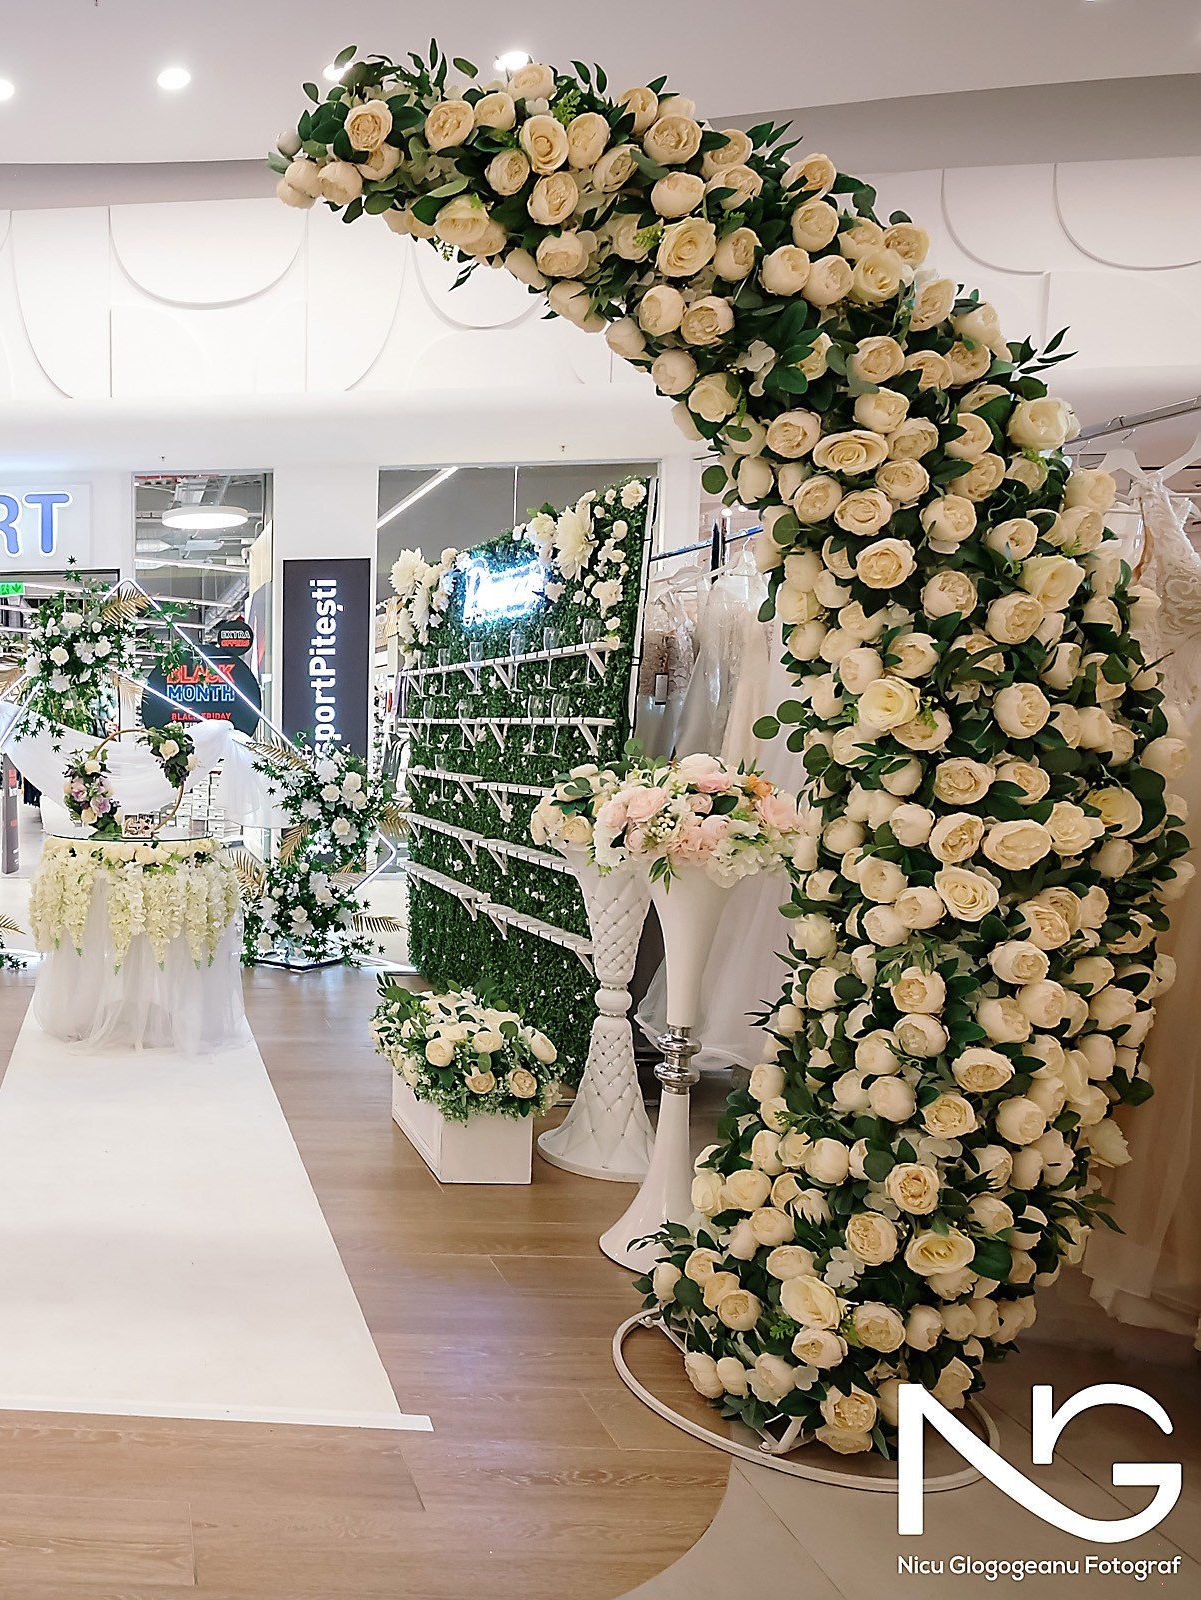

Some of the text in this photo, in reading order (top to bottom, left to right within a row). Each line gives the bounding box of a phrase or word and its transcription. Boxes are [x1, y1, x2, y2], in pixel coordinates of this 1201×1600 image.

[220, 630, 251, 639] EXTRA
[166, 684, 235, 702] MONTH
[171, 712, 200, 720] BLAC
